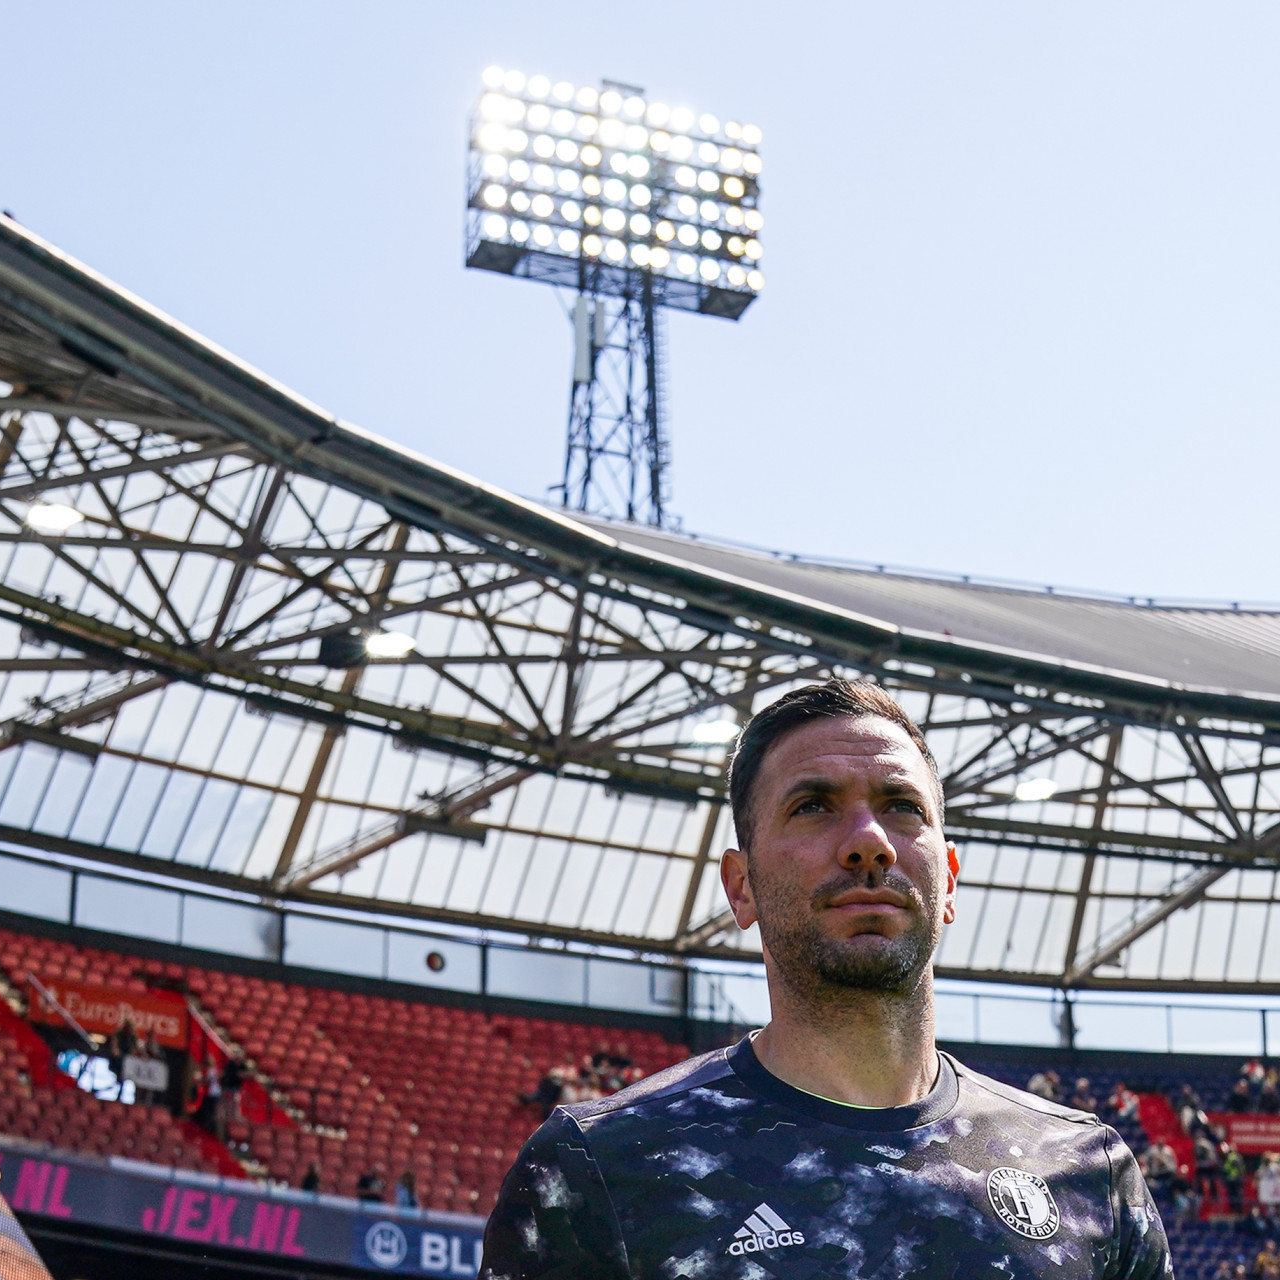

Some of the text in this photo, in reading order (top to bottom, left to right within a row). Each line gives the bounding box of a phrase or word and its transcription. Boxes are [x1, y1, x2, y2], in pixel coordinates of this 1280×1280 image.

[990, 1169, 1048, 1194] FEYENOORD
[141, 1186, 305, 1258] JEX.NL
[1000, 1208, 1057, 1236] ROTTERDAM
[728, 1228, 805, 1256] adidas
